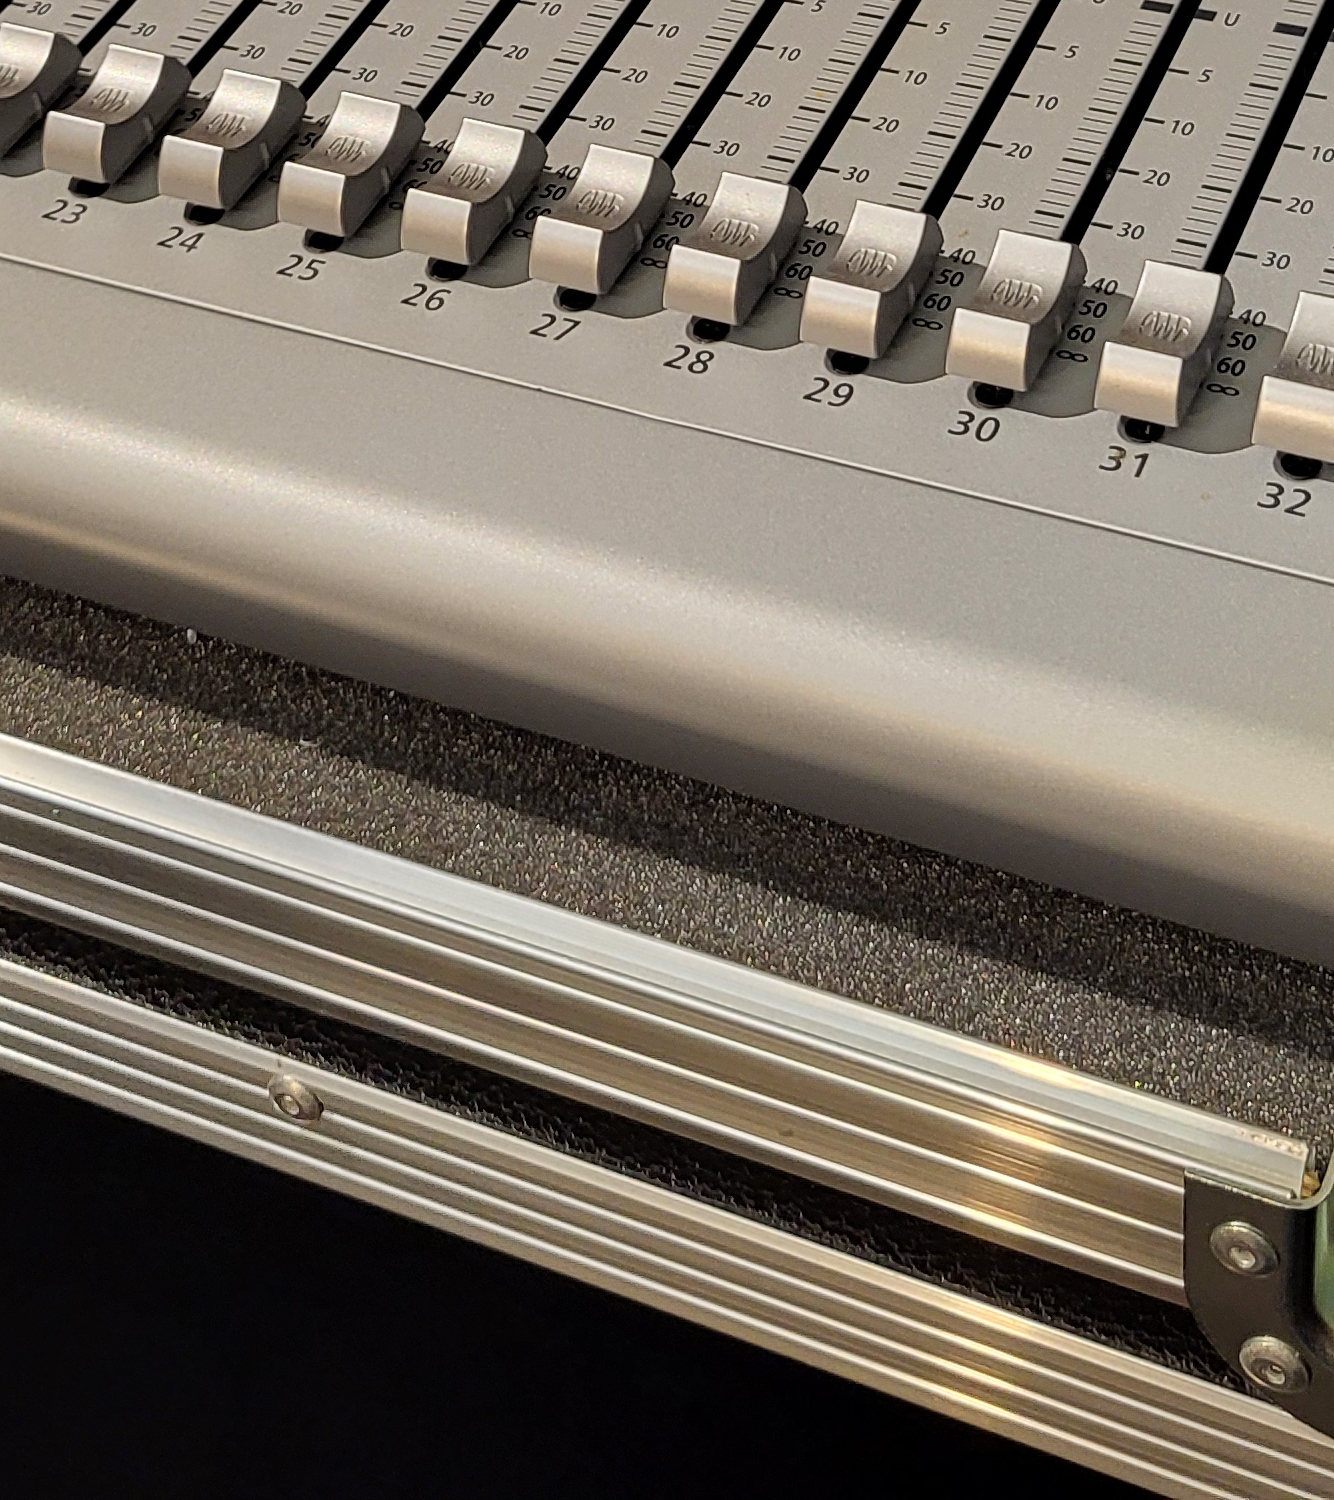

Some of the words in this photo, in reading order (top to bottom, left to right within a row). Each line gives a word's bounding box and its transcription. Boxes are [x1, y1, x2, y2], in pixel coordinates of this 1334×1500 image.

[41, 198, 89, 225] 23
[156, 225, 205, 254] 24
[275, 253, 327, 281] 25
[400, 282, 452, 312] 26
[528, 312, 582, 341] 27
[662, 344, 715, 375] 28
[802, 376, 855, 408] 29
[947, 410, 1001, 443] 30
[1098, 445, 1150, 478] 31
[1256, 481, 1312, 518] 32
